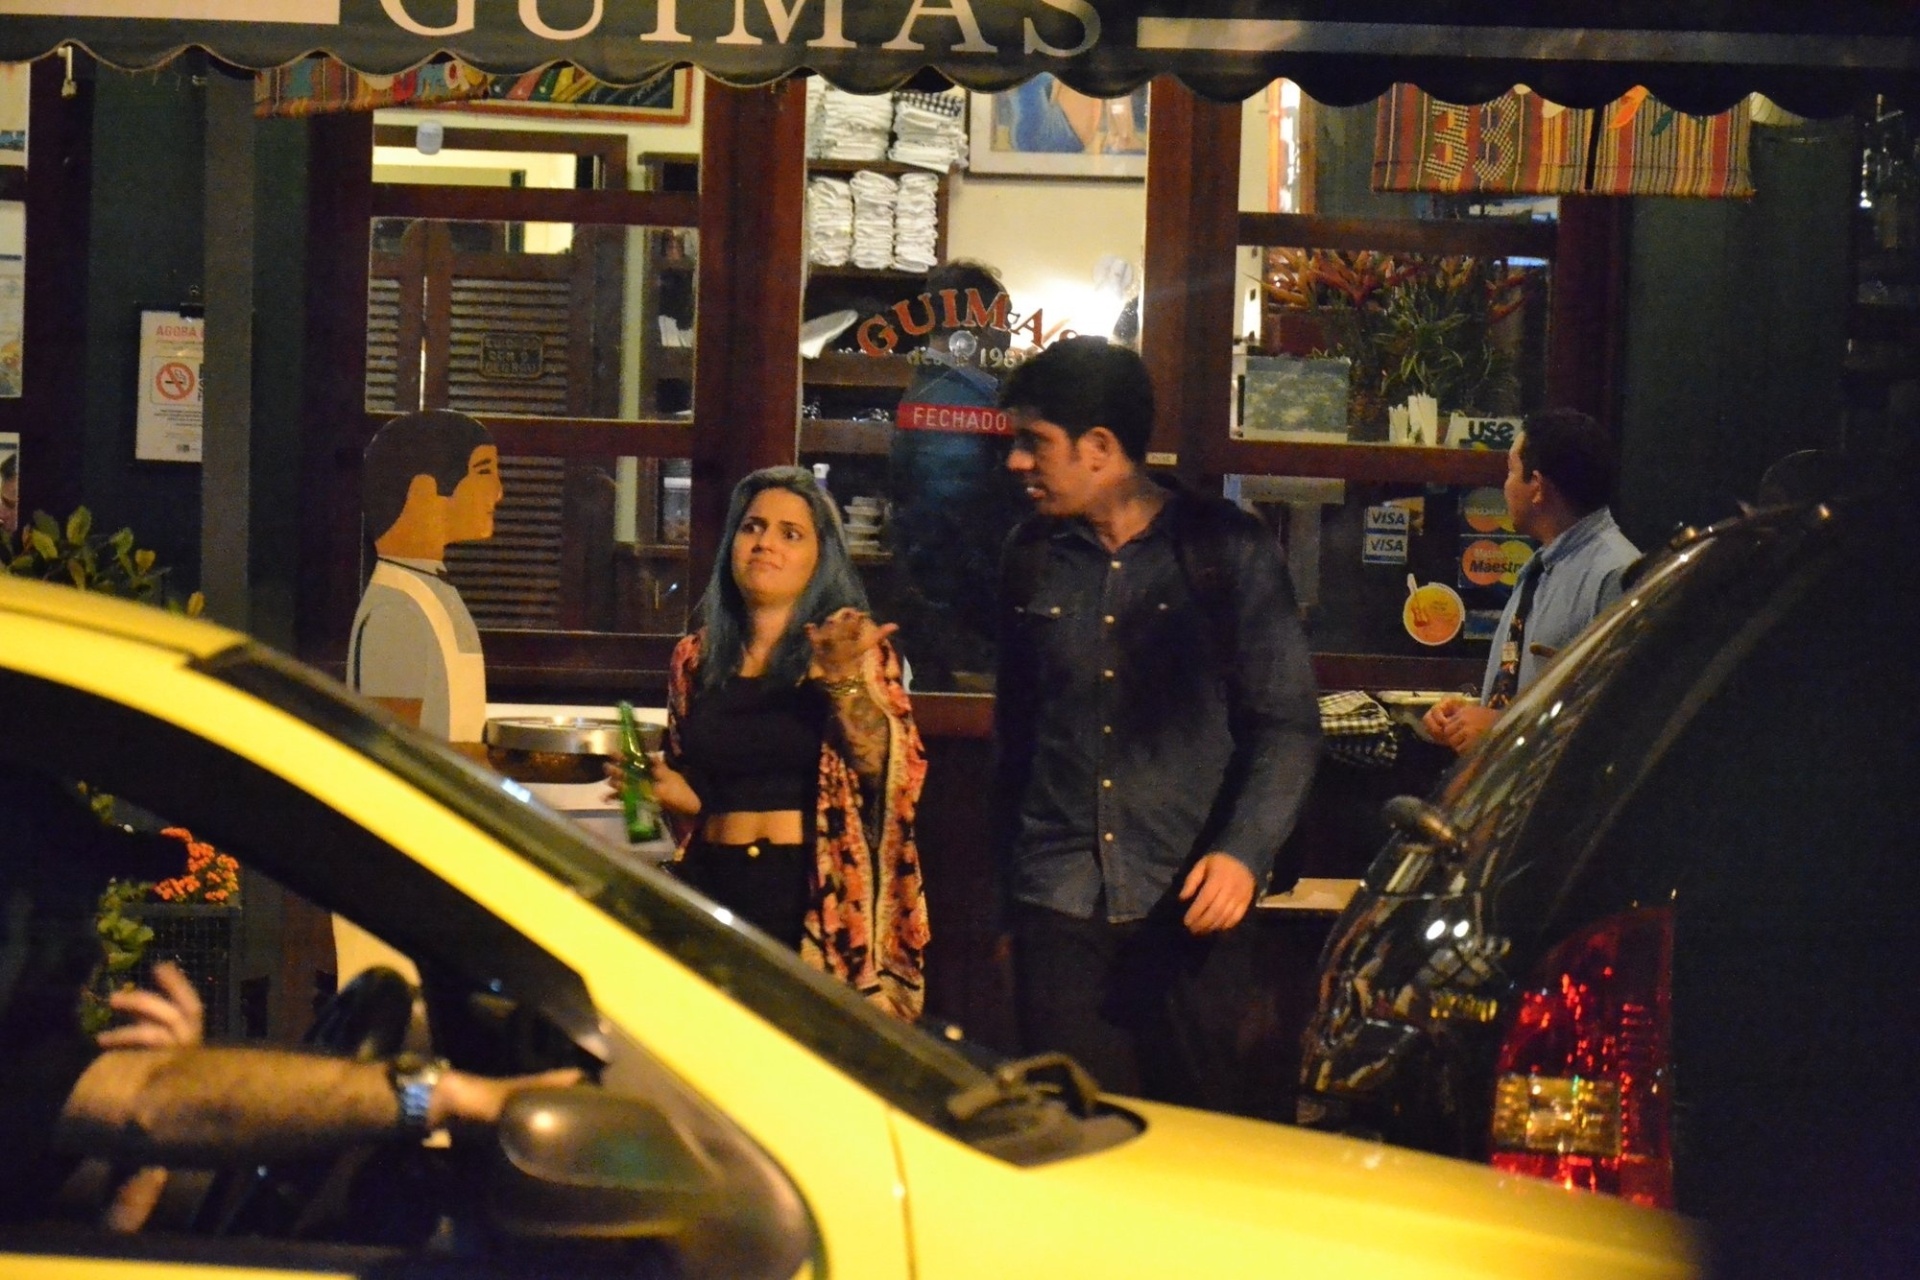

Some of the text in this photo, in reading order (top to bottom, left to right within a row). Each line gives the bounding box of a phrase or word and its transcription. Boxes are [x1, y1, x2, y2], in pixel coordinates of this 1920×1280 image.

[857, 288, 1078, 357] GUIMA
[913, 407, 1007, 431] FECHADO
[1371, 511, 1405, 525] VISA
[1370, 539, 1404, 552] VISA
[1469, 560, 1521, 574] Maestr
